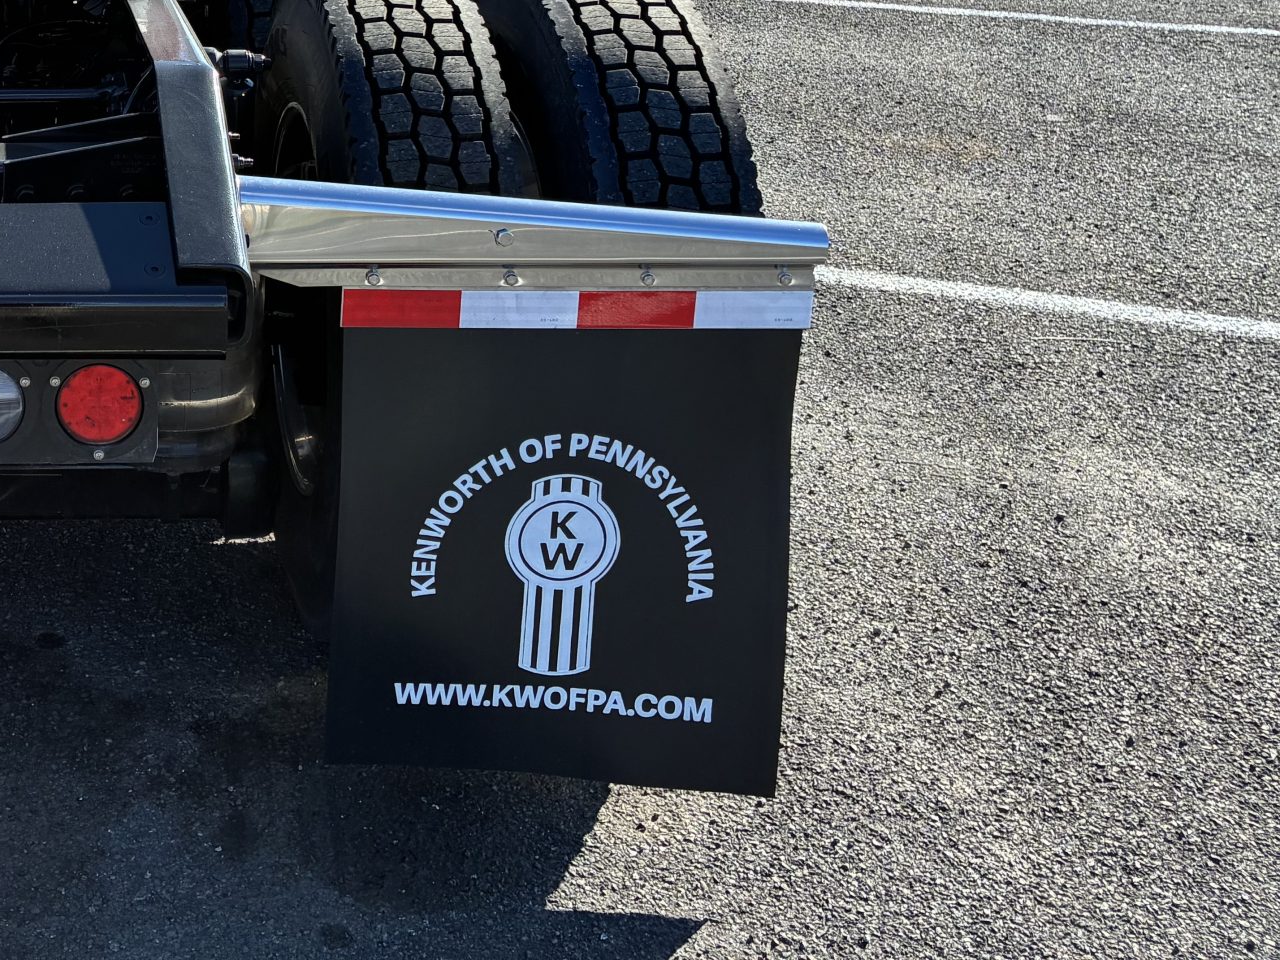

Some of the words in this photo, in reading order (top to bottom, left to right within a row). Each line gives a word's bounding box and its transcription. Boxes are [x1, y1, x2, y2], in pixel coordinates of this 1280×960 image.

[410, 447, 516, 597] KENWORTH
[518, 433, 562, 464] OF
[568, 432, 715, 603] PENNSYLVANIA
[549, 510, 579, 540] K
[539, 542, 585, 571] W
[393, 681, 714, 724] WWW.KWOFPA.COM
